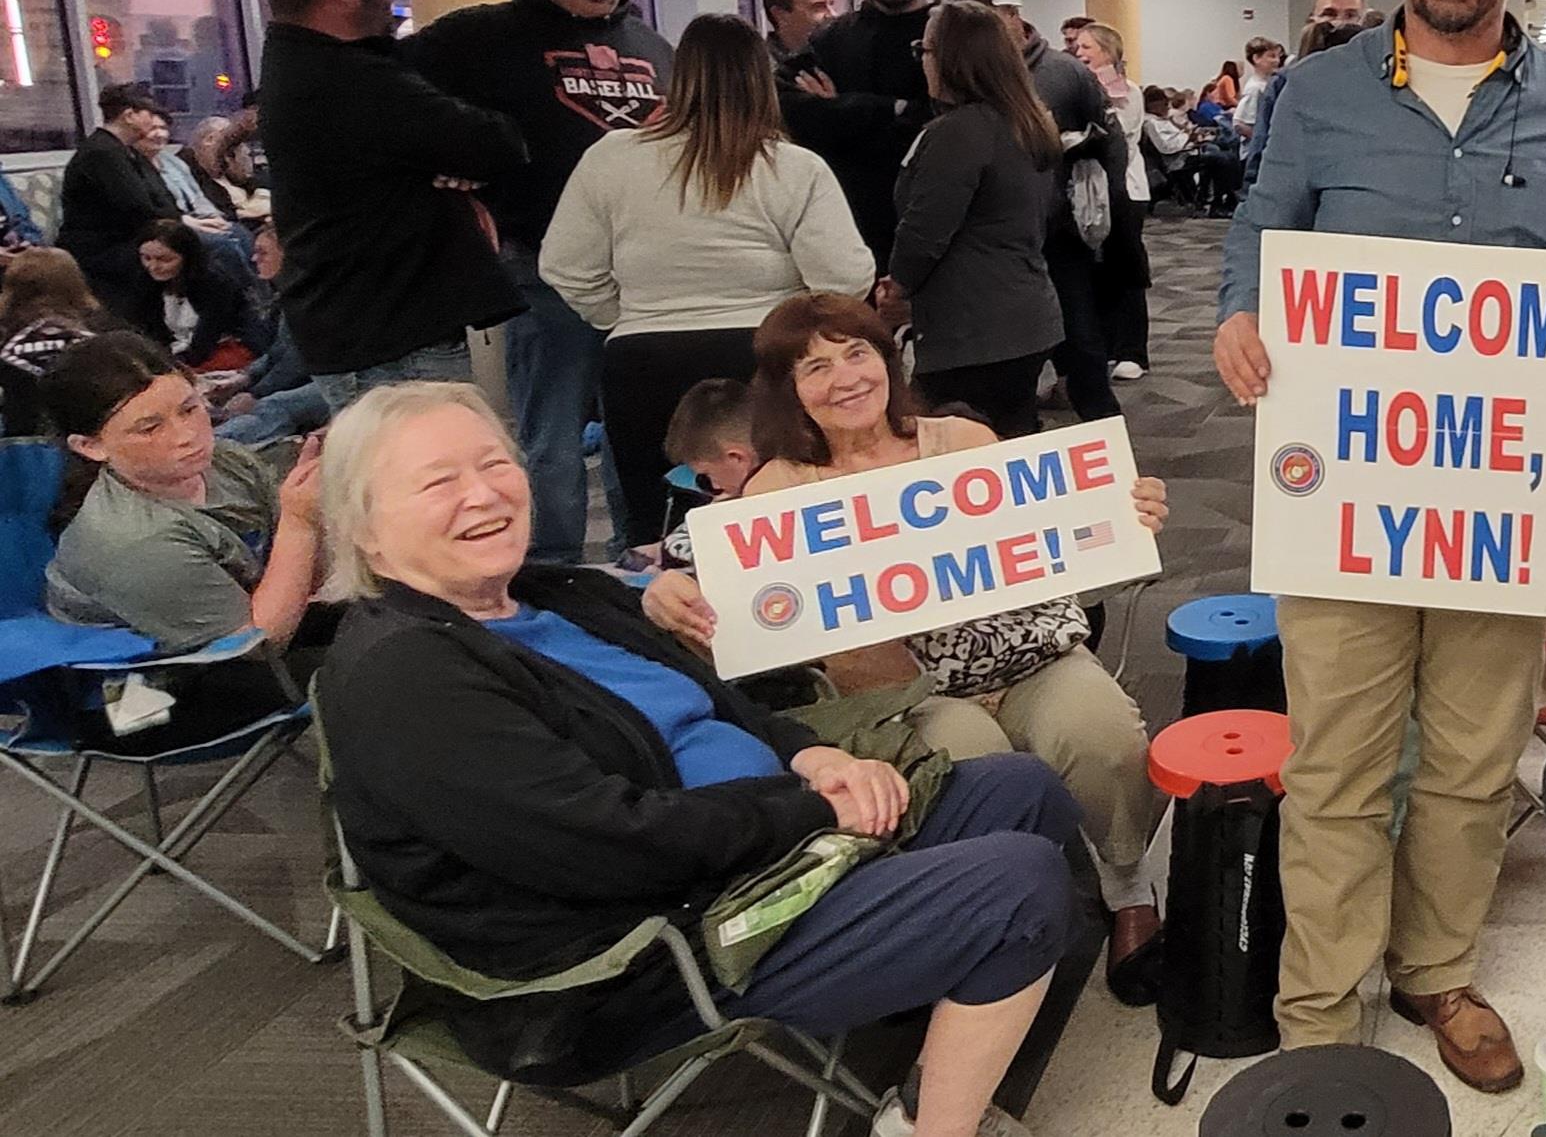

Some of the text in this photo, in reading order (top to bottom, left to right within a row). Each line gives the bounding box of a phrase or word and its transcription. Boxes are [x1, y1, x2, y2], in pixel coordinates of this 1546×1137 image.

[1337, 388, 1544, 492] HOME,
[724, 439, 1115, 570] WELCOME
[1339, 502, 1534, 585] LYNN!
[816, 527, 1066, 631] HOME!
